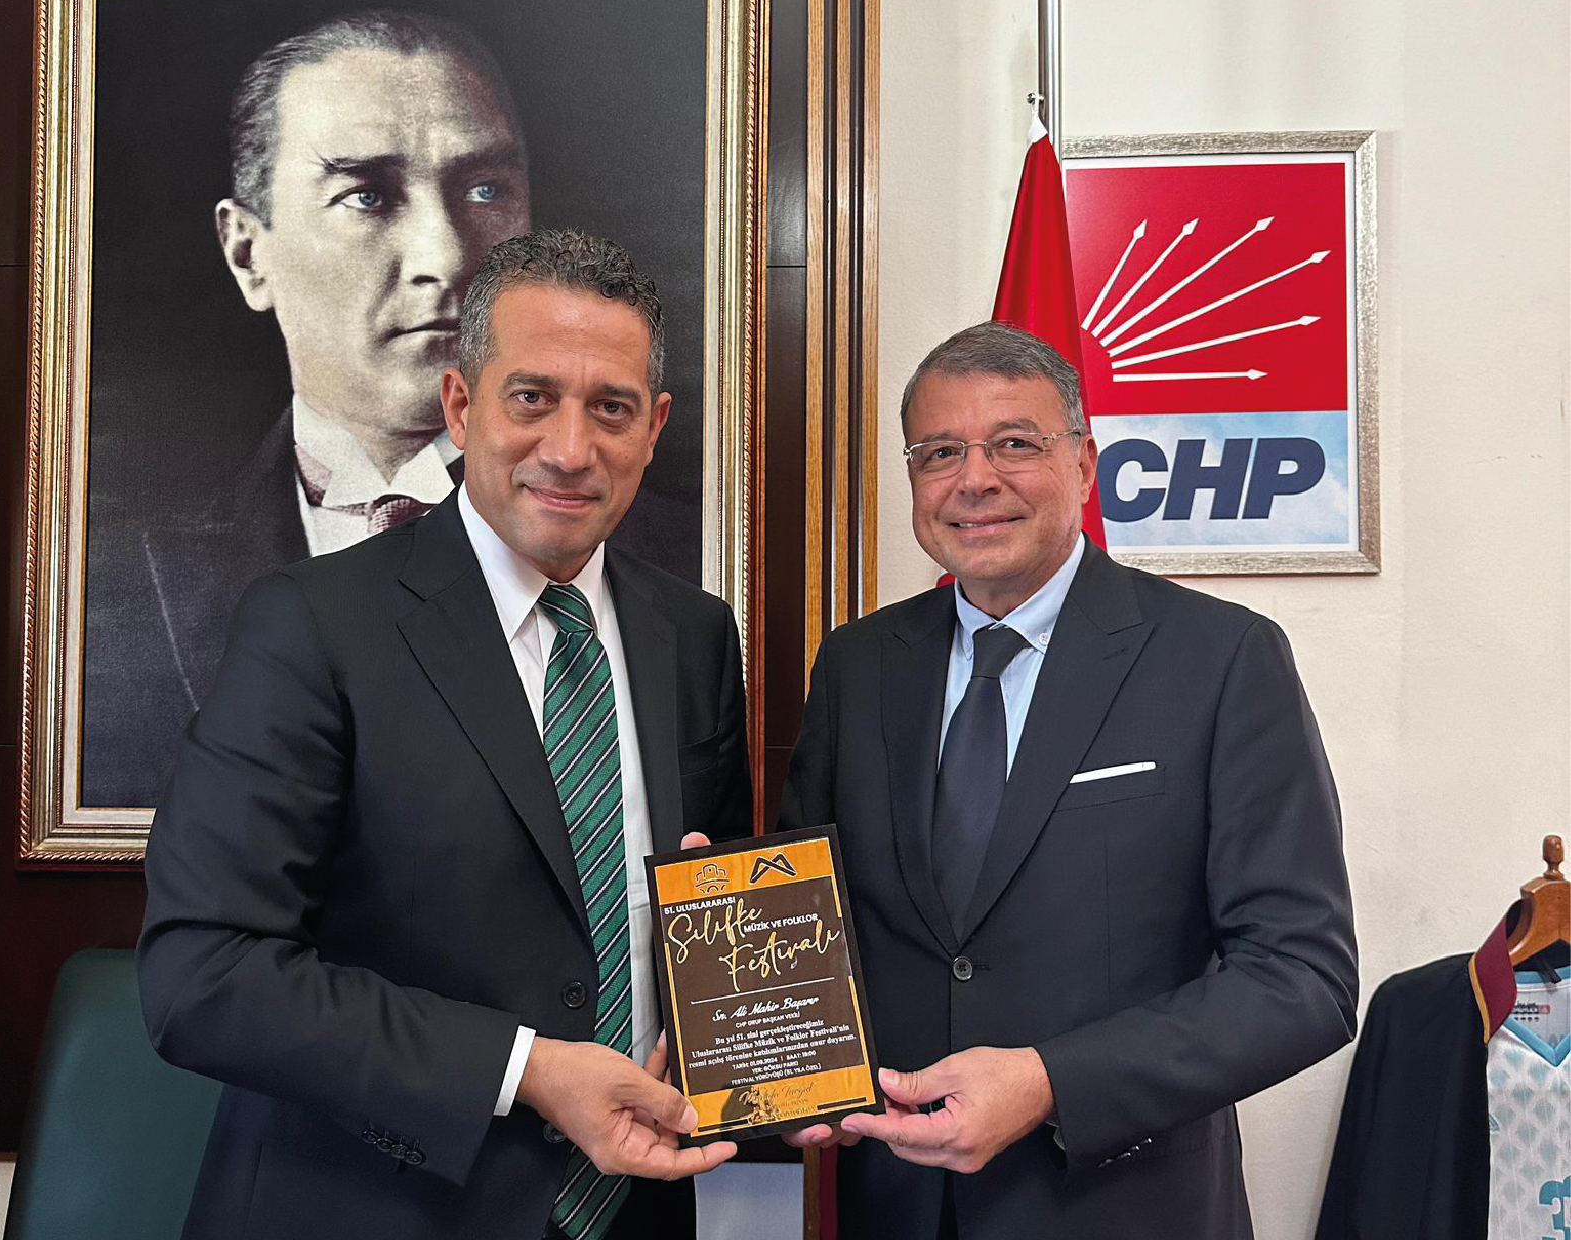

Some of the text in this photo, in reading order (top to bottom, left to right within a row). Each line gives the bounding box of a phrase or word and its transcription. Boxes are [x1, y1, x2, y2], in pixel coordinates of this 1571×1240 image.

[1097, 437, 1326, 523] CHP
[664, 896, 736, 915] 51. ULUSLARARASI
[743, 913, 819, 933] MÜZİK VE FOLKLOR
